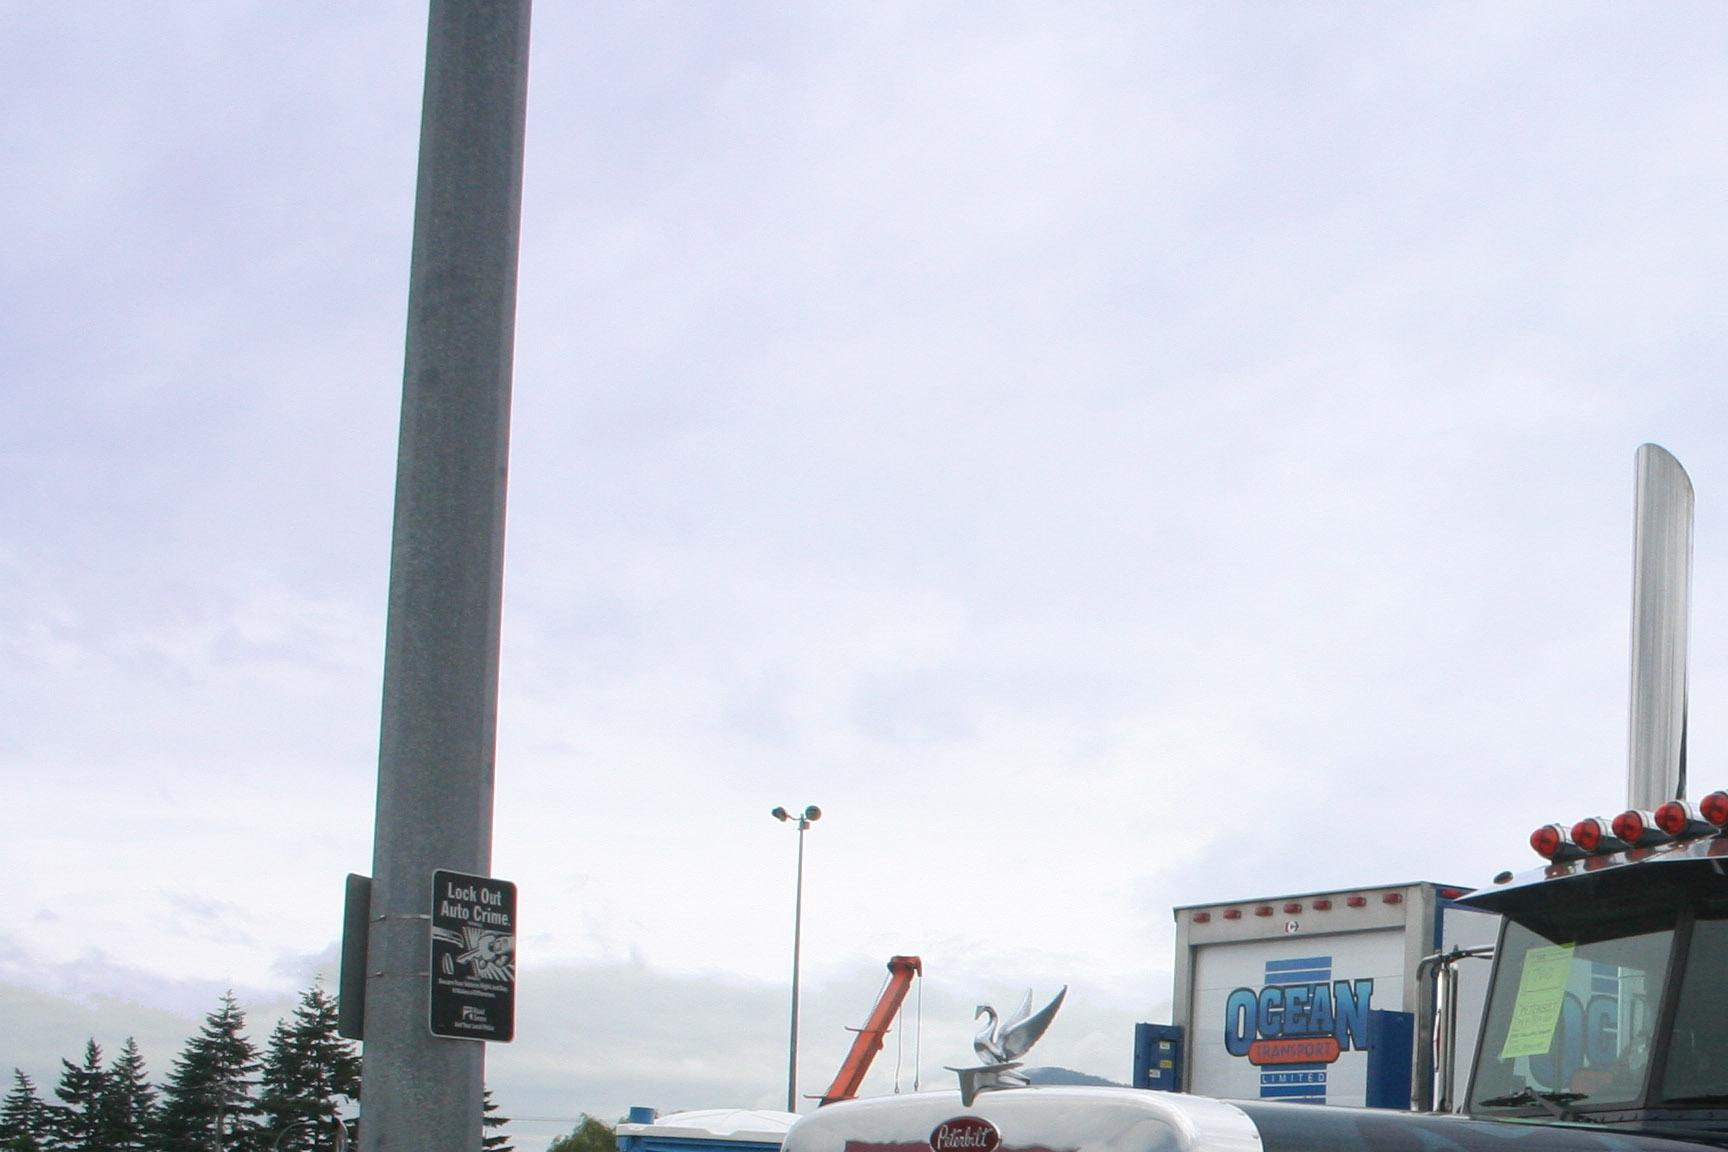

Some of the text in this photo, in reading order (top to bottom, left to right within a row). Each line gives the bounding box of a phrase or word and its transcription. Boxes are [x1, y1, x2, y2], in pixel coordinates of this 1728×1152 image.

[448, 882, 502, 906] Lock Out
[441, 900, 511, 926] Auto Crime.
[1225, 977, 1374, 1057] OCEAN
[1257, 1041, 1332, 1058] TRANSPORT
[1262, 1073, 1325, 1083] LIMITED
[937, 1124, 993, 1150] Peterbilt
